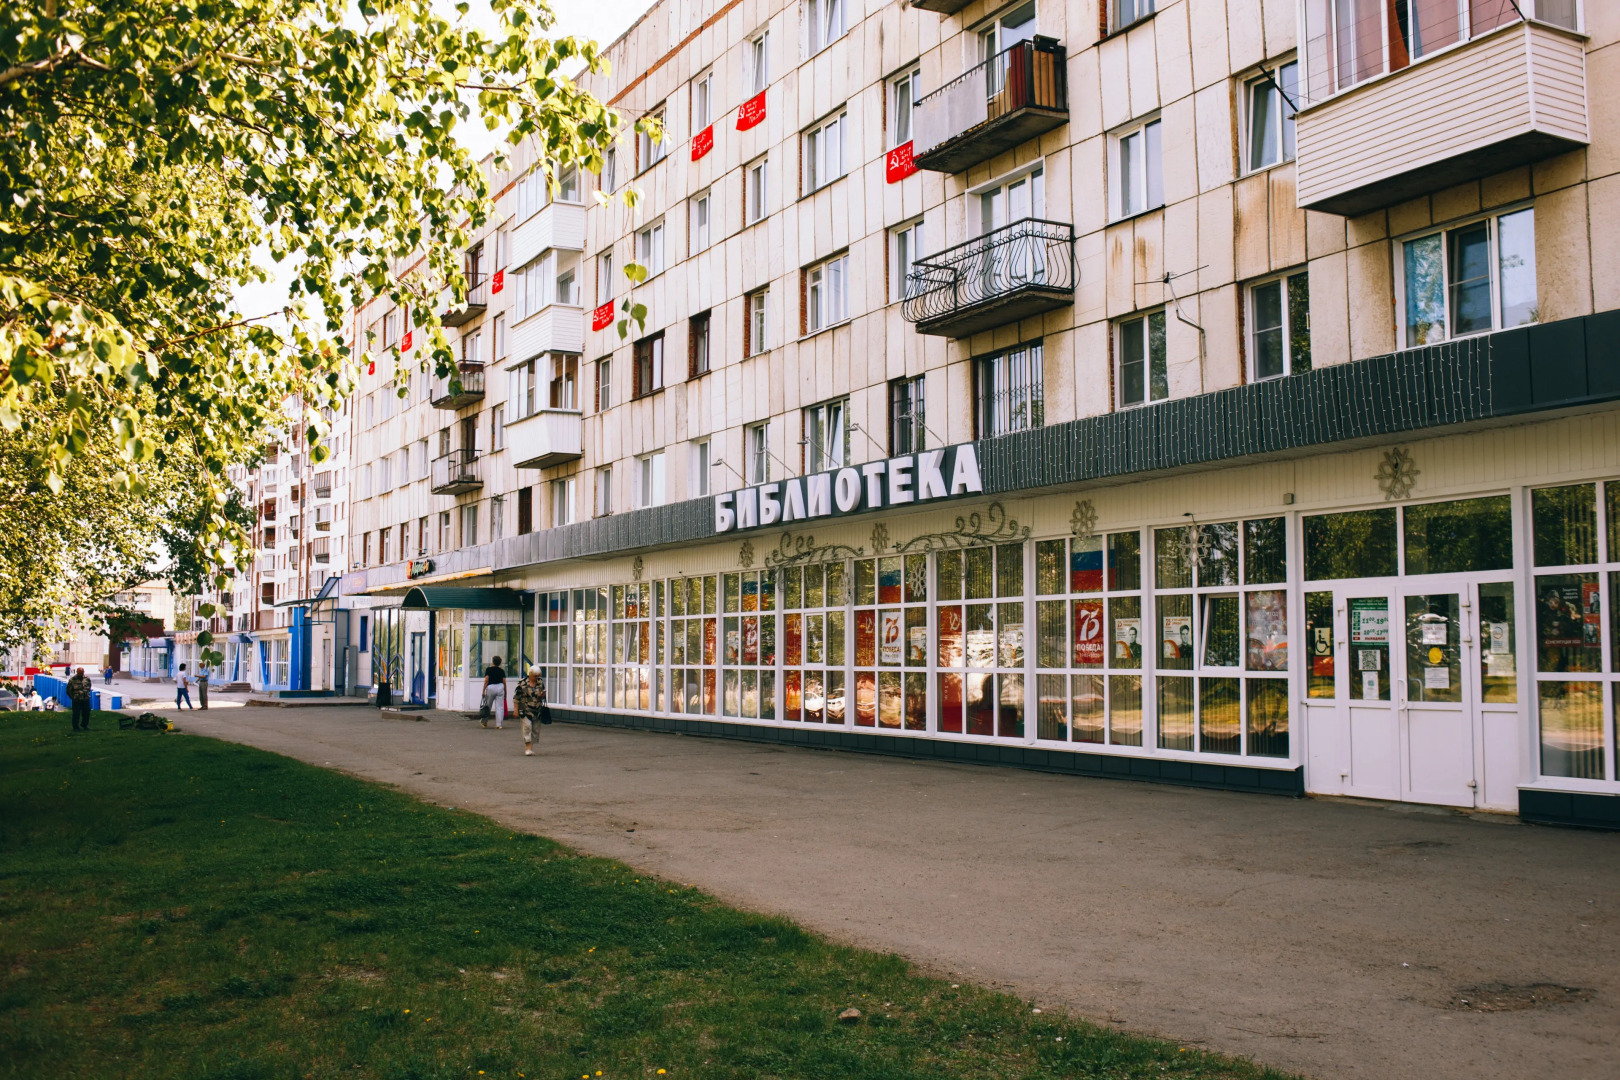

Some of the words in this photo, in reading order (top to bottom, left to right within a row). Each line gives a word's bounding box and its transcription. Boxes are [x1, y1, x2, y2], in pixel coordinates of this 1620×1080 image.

[715, 444, 983, 532] БИБЛИОТЕКА
[885, 616, 900, 644] 75
[1079, 608, 1100, 641] 75
